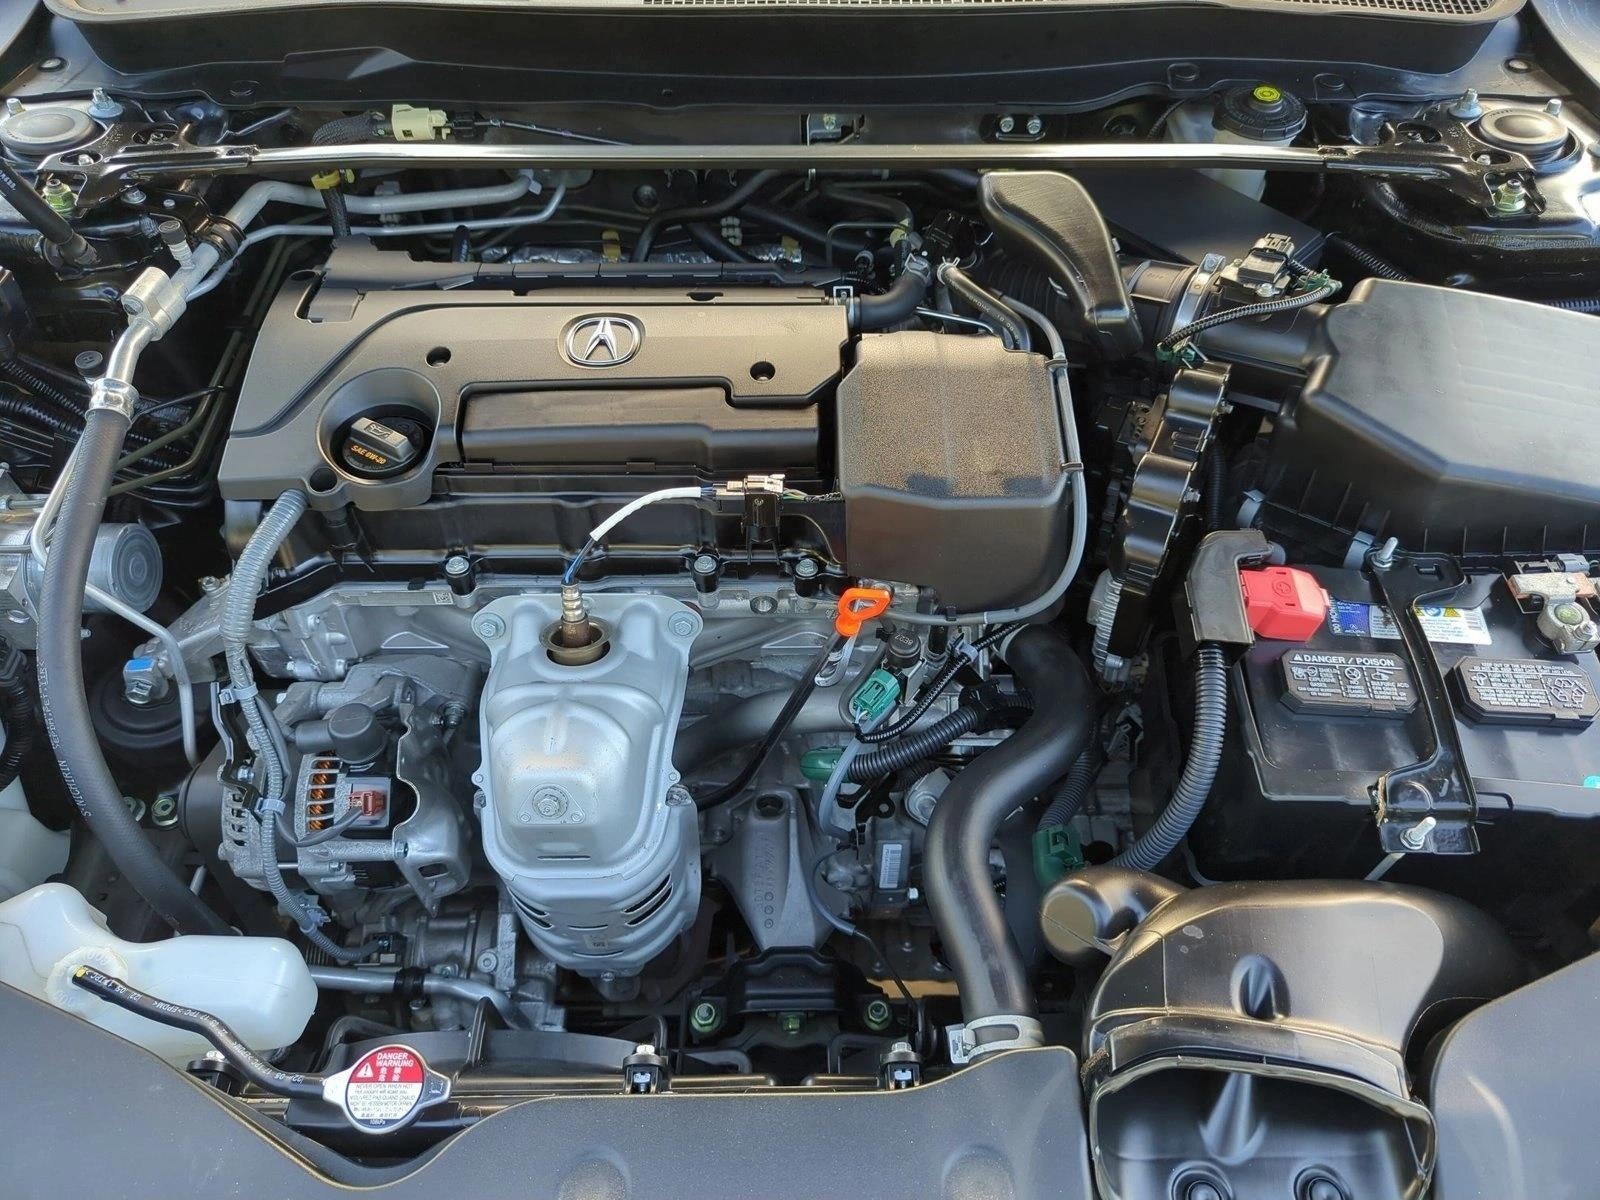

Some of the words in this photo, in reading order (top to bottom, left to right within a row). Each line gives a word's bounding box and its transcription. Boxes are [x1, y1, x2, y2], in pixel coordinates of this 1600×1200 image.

[351, 445, 367, 456] SAE
[1303, 654, 1346, 664] DANGER
[1355, 657, 1395, 667] POISON
[376, 1052, 409, 1060] DANGER
[375, 1059, 415, 1067] WARNUNG
